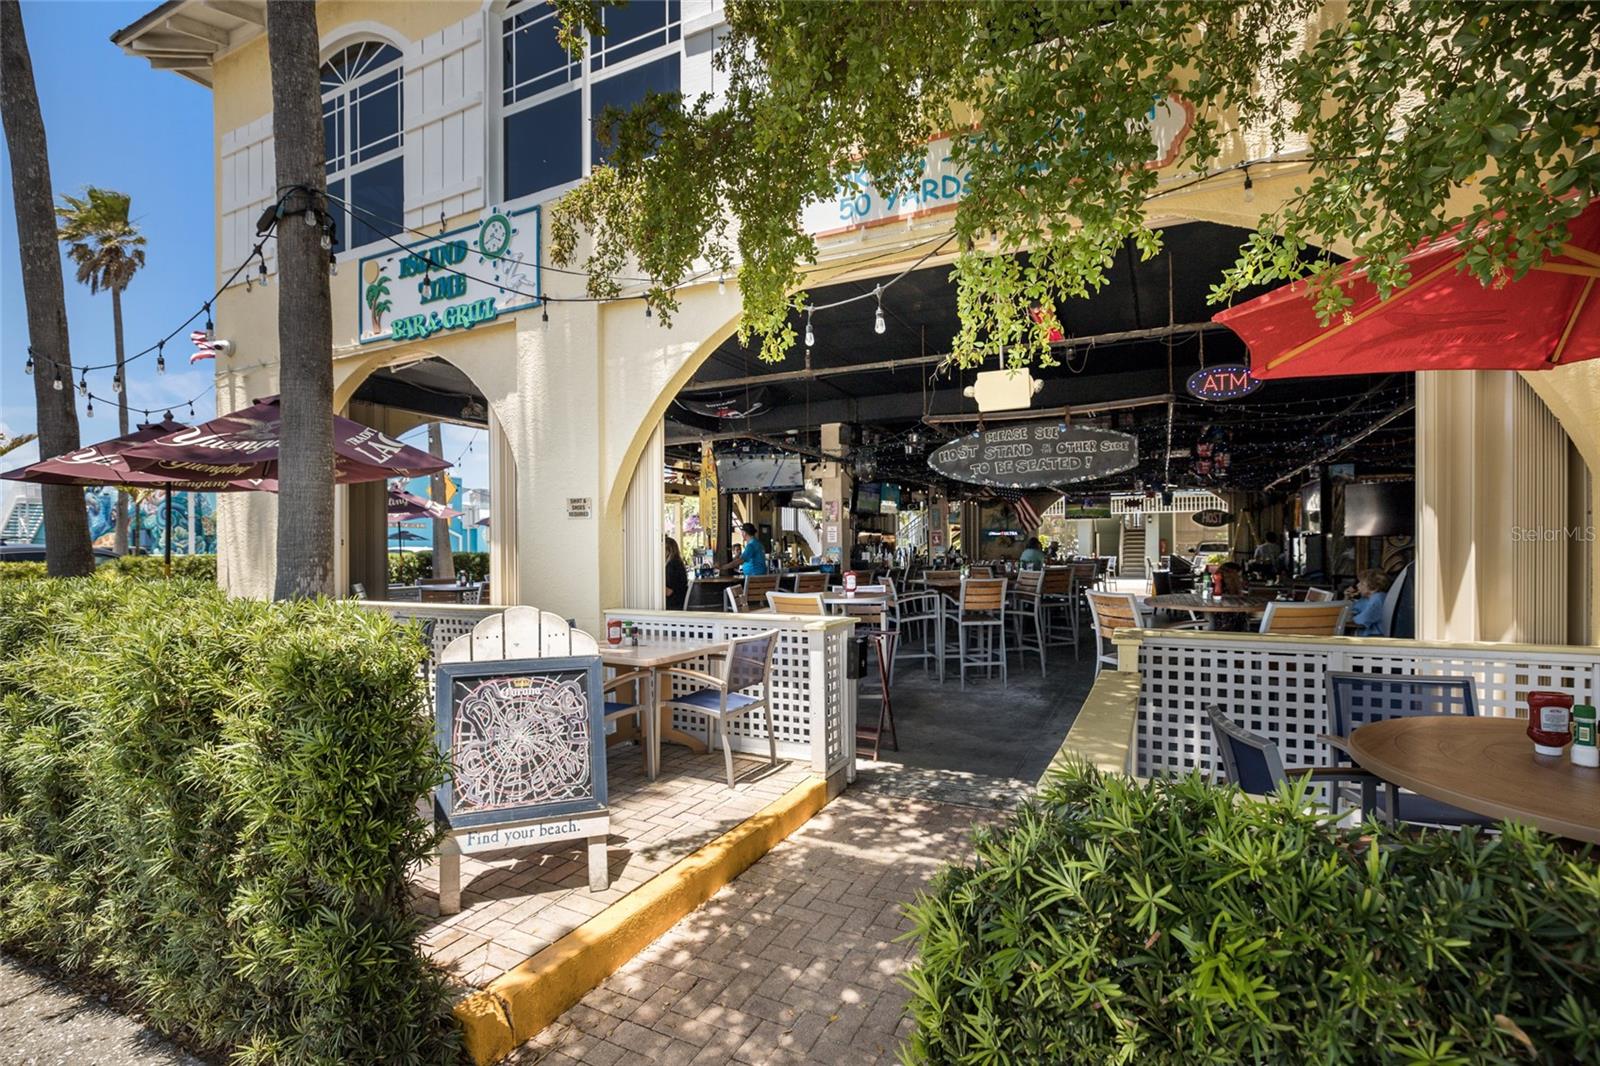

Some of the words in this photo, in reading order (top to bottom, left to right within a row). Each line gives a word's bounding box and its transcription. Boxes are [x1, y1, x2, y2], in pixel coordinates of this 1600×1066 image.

[840, 193, 871, 221] 50
[391, 314, 431, 341] BAR
[428, 311, 443, 332] &
[442, 297, 498, 329] GRILL
[1203, 372, 1247, 391] ATM
[985, 427, 1028, 444] PLEASE
[1035, 426, 1060, 440] SEE
[938, 444, 979, 463] HOST
[984, 444, 1033, 460] STAND
[1056, 440, 1098, 454] OTHER
[970, 462, 991, 475] TO
[995, 460, 1014, 475] BE
[499, 687, 543, 699] Corona
[467, 828, 499, 846] Find
[504, 828, 535, 846] your
[539, 818, 581, 837] beach.
